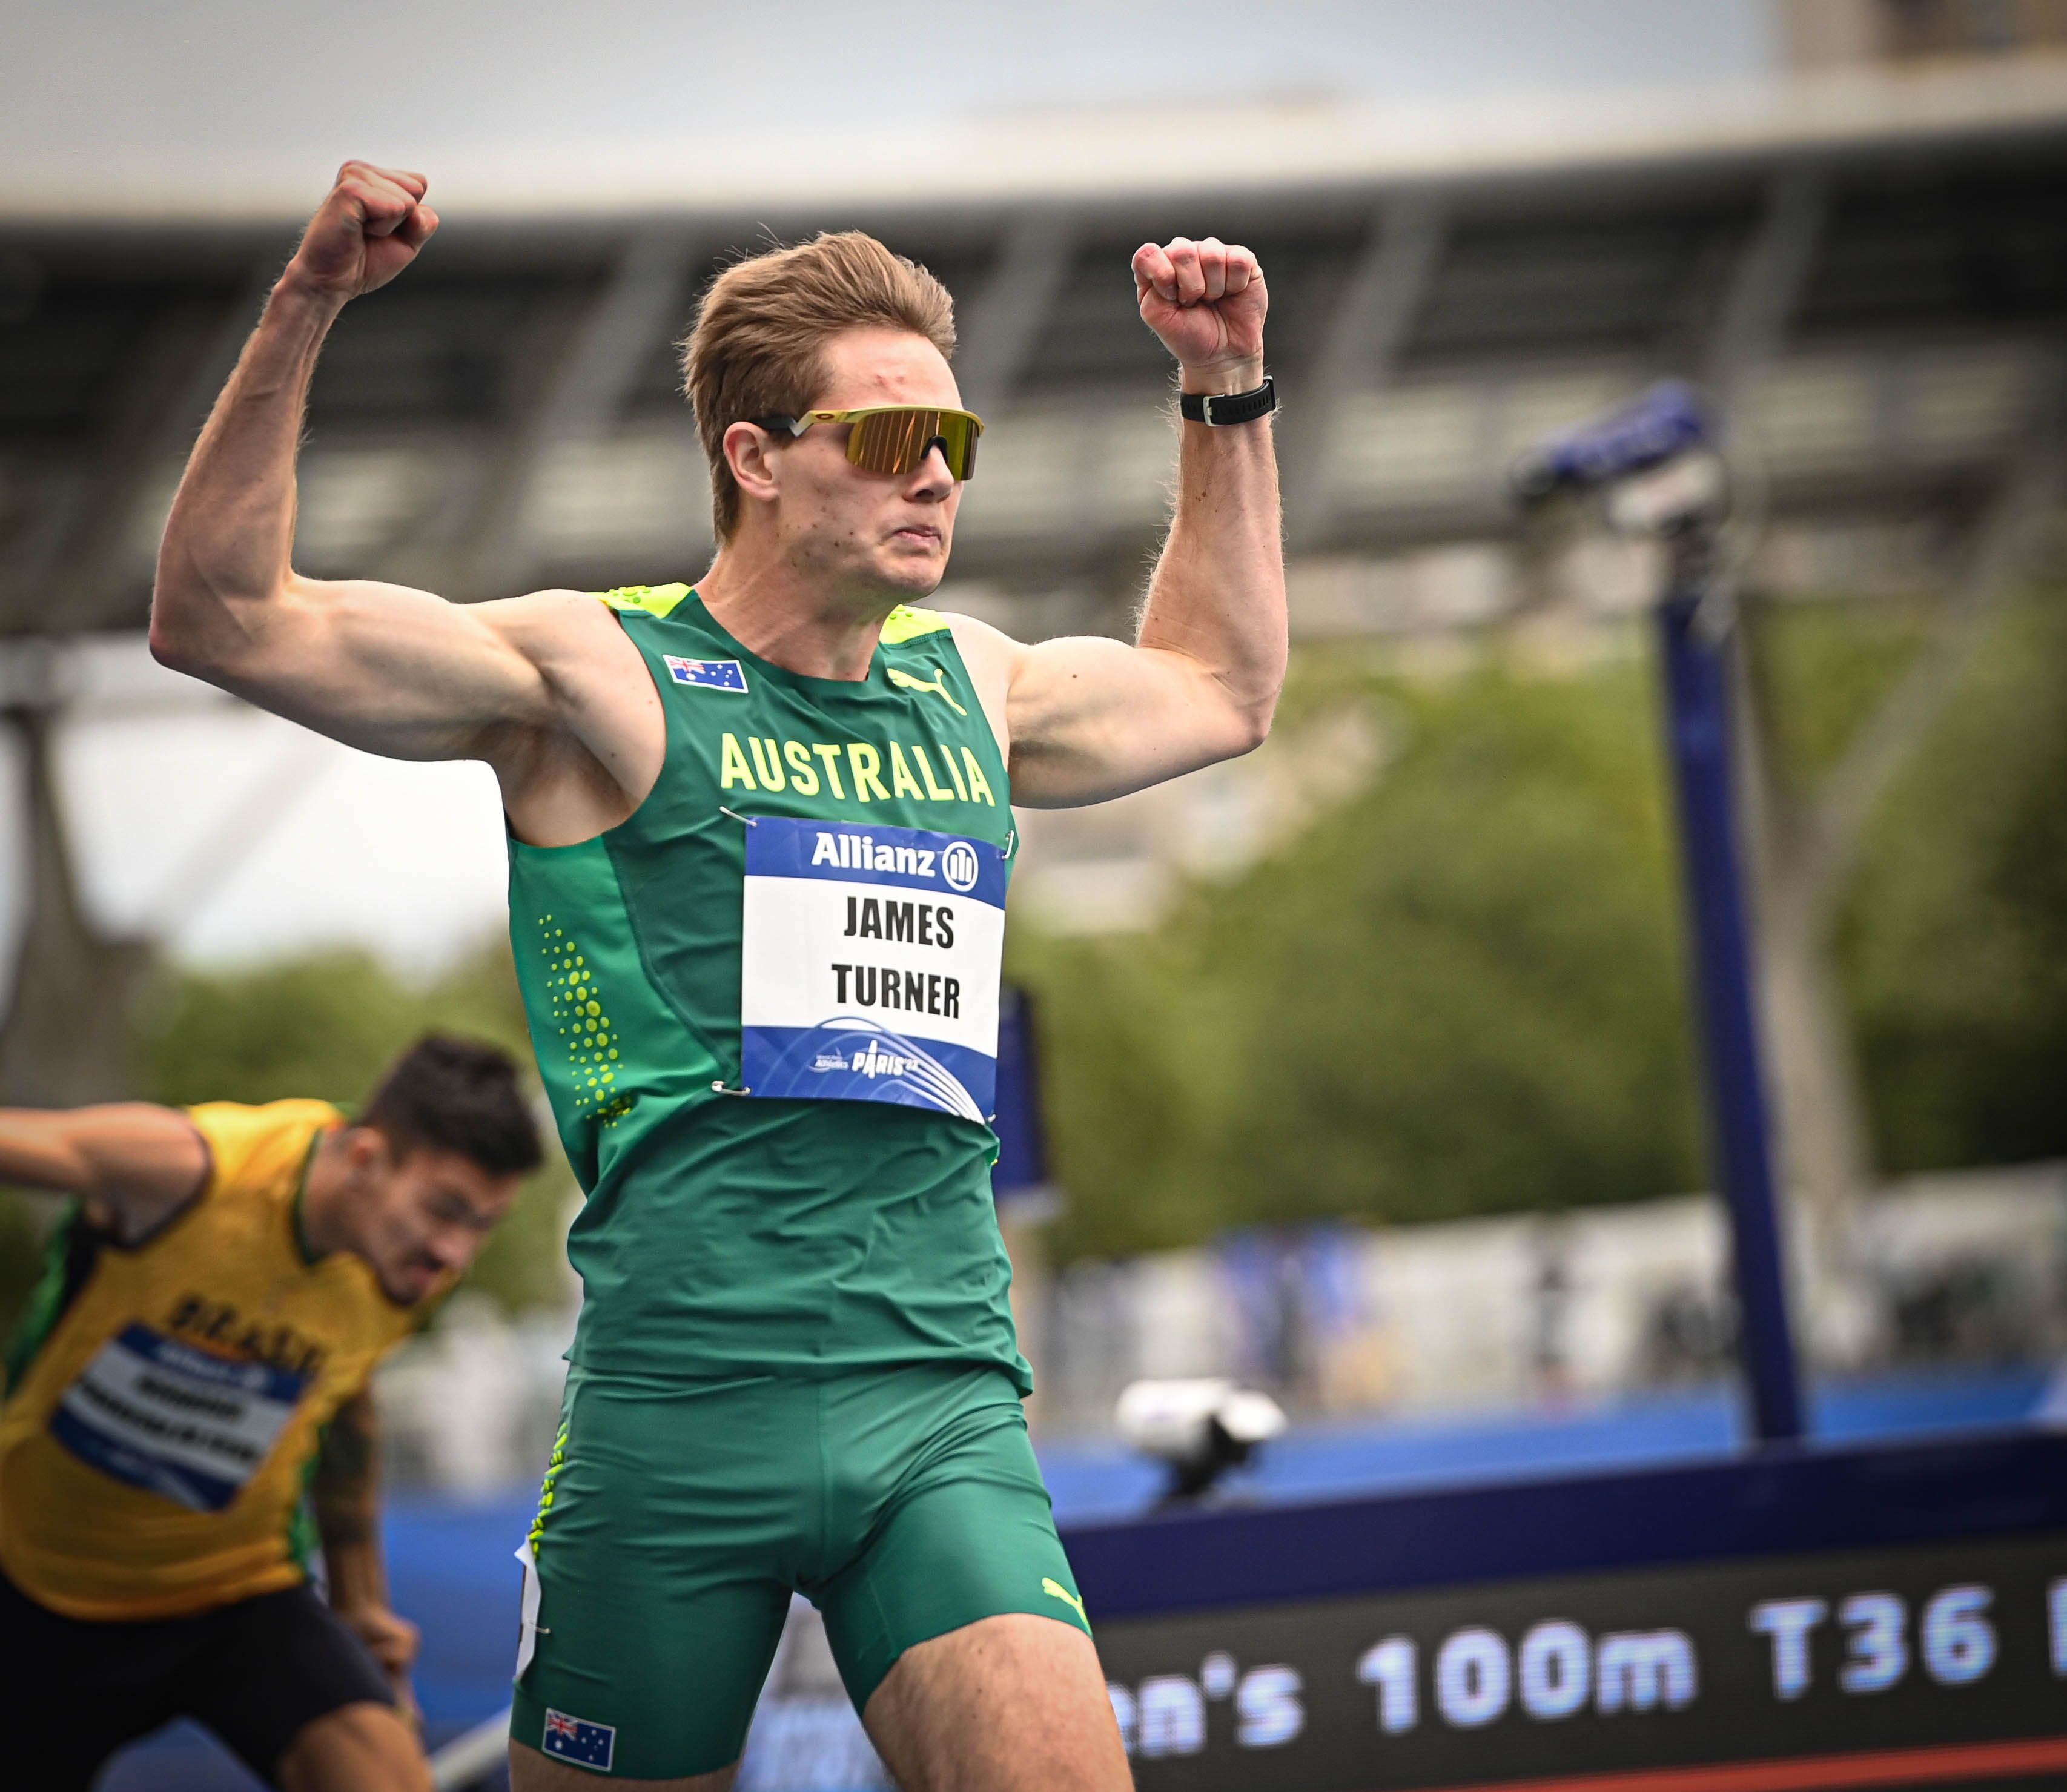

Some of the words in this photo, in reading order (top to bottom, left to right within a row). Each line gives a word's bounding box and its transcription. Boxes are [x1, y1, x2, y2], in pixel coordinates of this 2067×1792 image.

[720, 732, 996, 808] AUSTRALIA
[810, 831, 936, 878] Allianz
[843, 896, 955, 950] JAMES
[830, 963, 961, 1020] TURNER
[1357, 1619, 1696, 1733] 100m
[1752, 1585, 1995, 1694] T36
